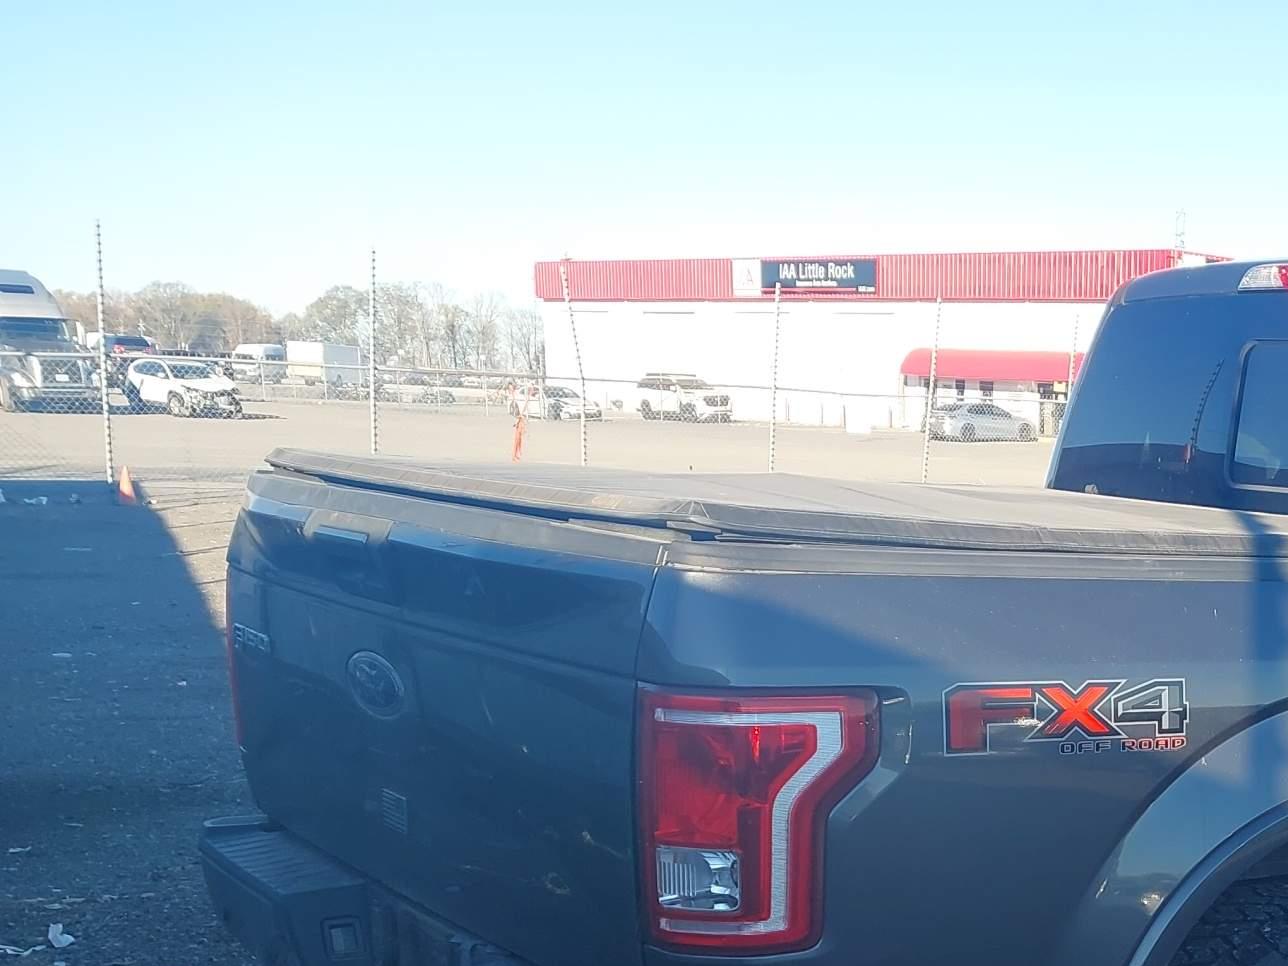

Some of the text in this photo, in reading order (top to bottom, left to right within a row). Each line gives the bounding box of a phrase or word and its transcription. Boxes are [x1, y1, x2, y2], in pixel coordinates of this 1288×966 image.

[779, 262, 855, 279] IAA Little Rock
[941, 678, 1190, 757] FX4
[1060, 736, 1187, 755] OFF ROAD
